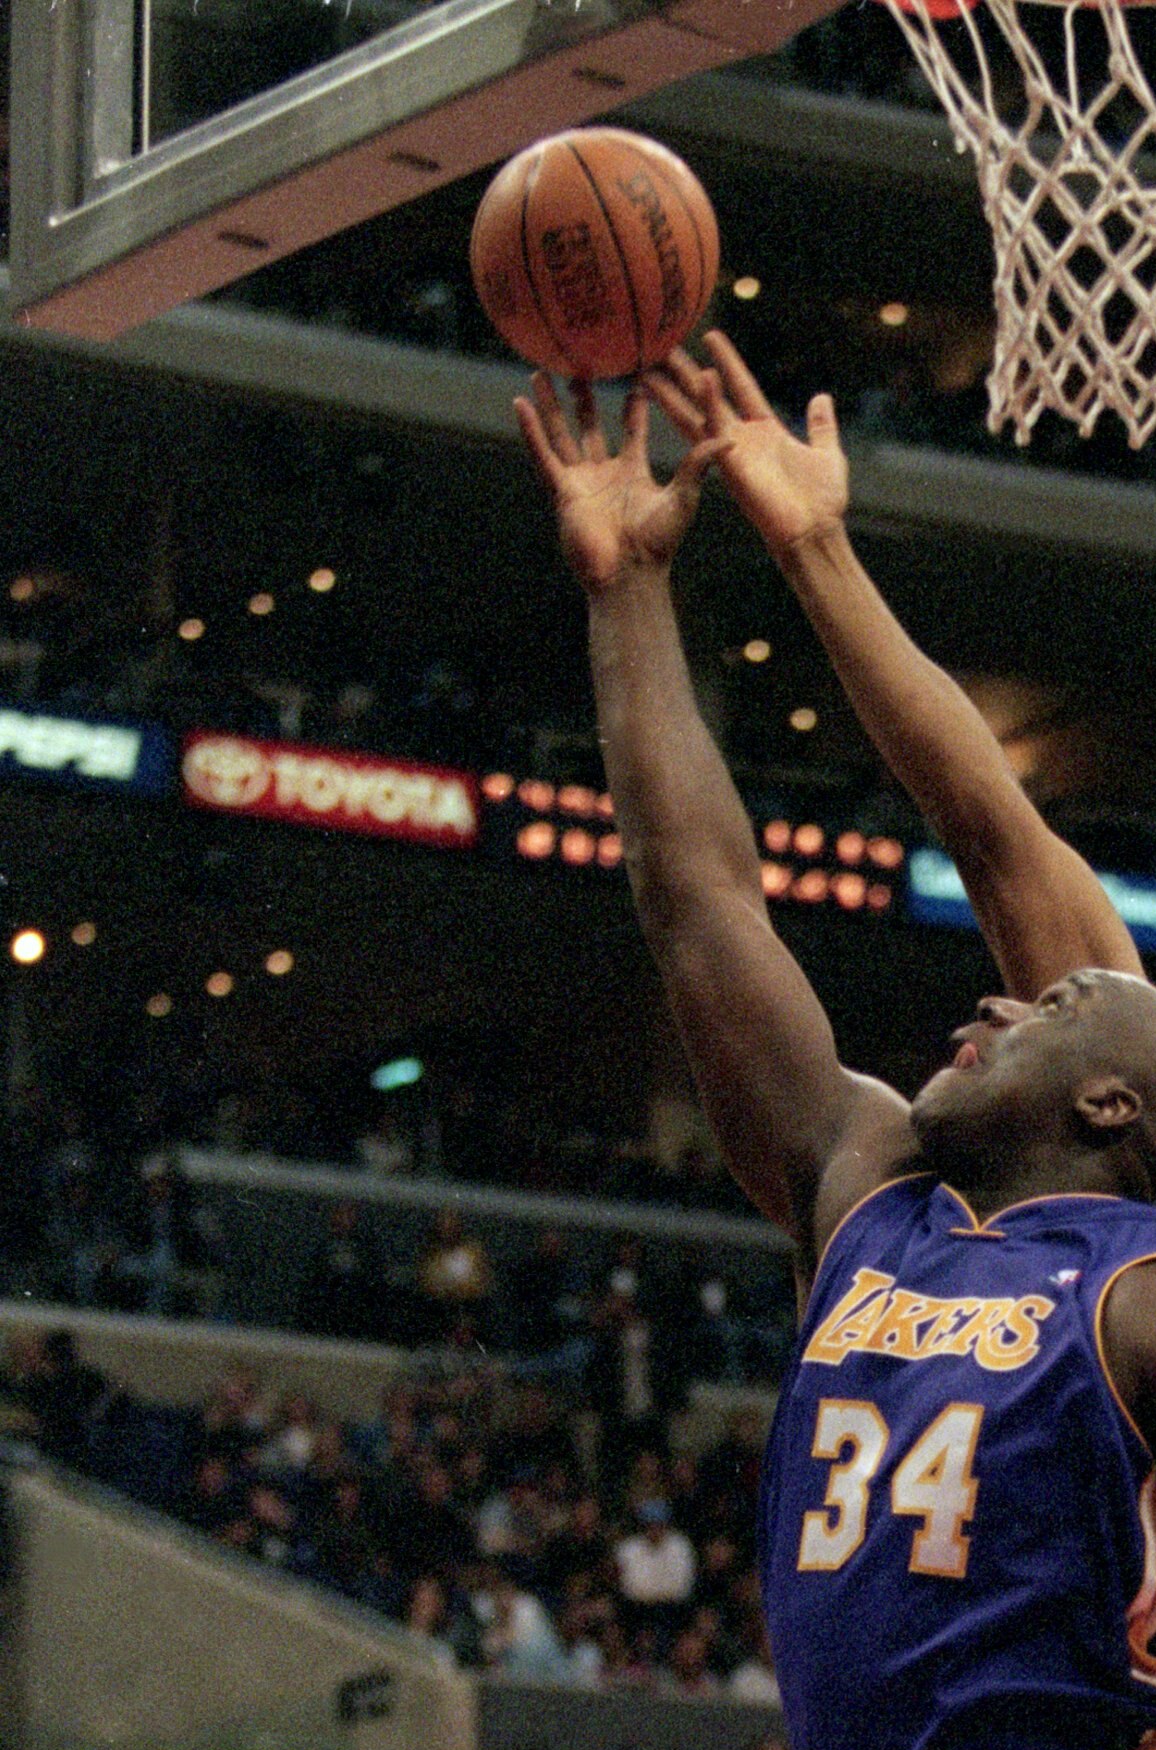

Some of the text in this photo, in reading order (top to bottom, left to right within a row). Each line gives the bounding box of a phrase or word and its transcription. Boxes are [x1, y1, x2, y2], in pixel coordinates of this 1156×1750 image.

[274, 753, 478, 838] TOYOTA
[801, 1267, 1056, 1372] LAKERS
[797, 1398, 985, 1579] 34
